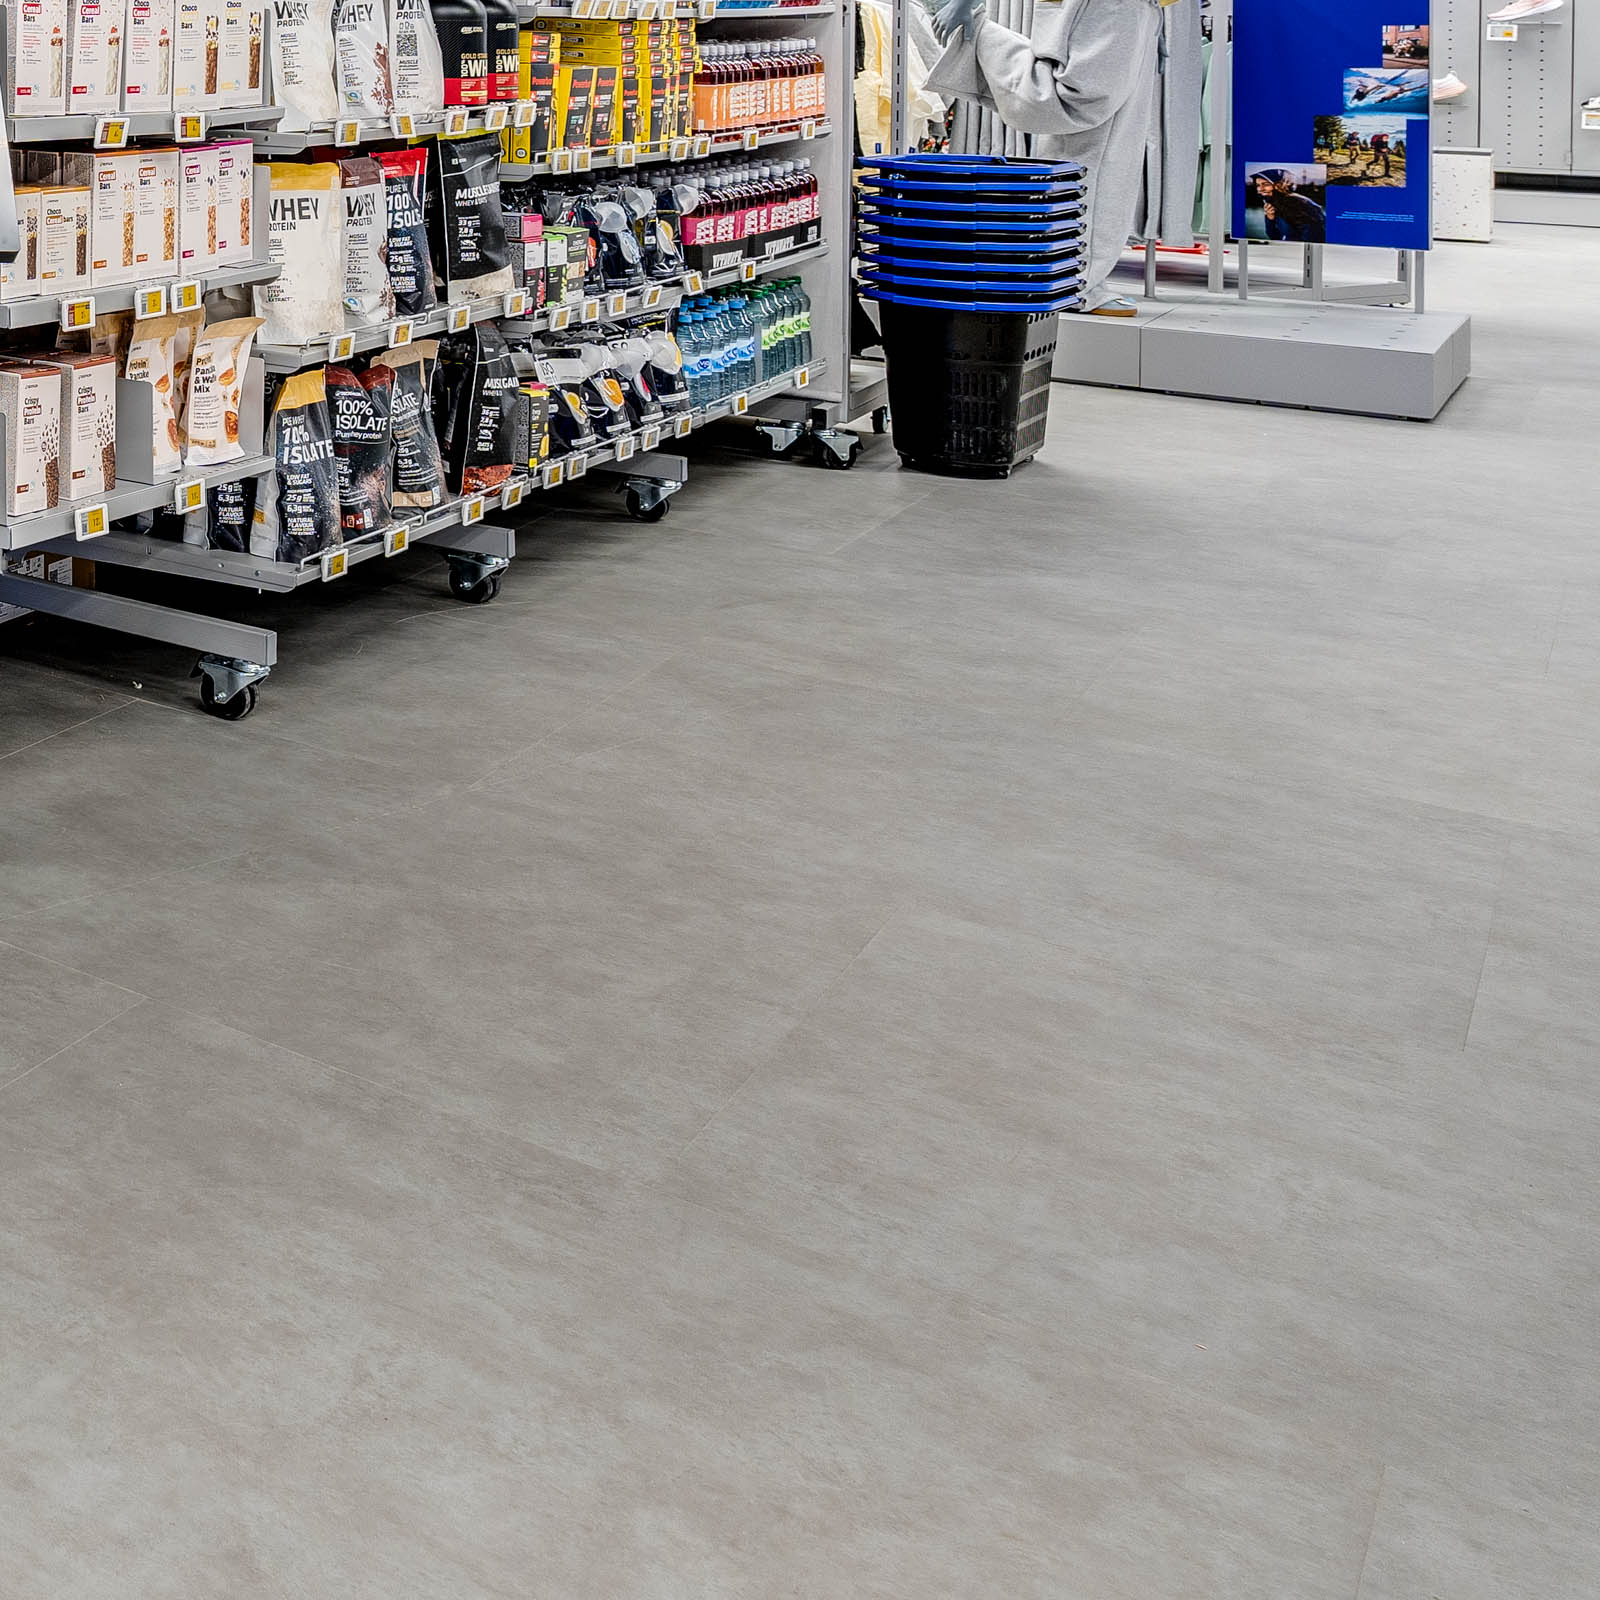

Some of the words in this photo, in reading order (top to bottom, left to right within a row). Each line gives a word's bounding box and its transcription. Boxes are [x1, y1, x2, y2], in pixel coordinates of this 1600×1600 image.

[273, 0, 309, 21] WHEY
[23, 14, 36, 23] Bars
[81, 16, 94, 24] Bars
[193, 384, 211, 394] Mix
[335, 400, 374, 416] 100%
[335, 414, 388, 432] ISOLATE
